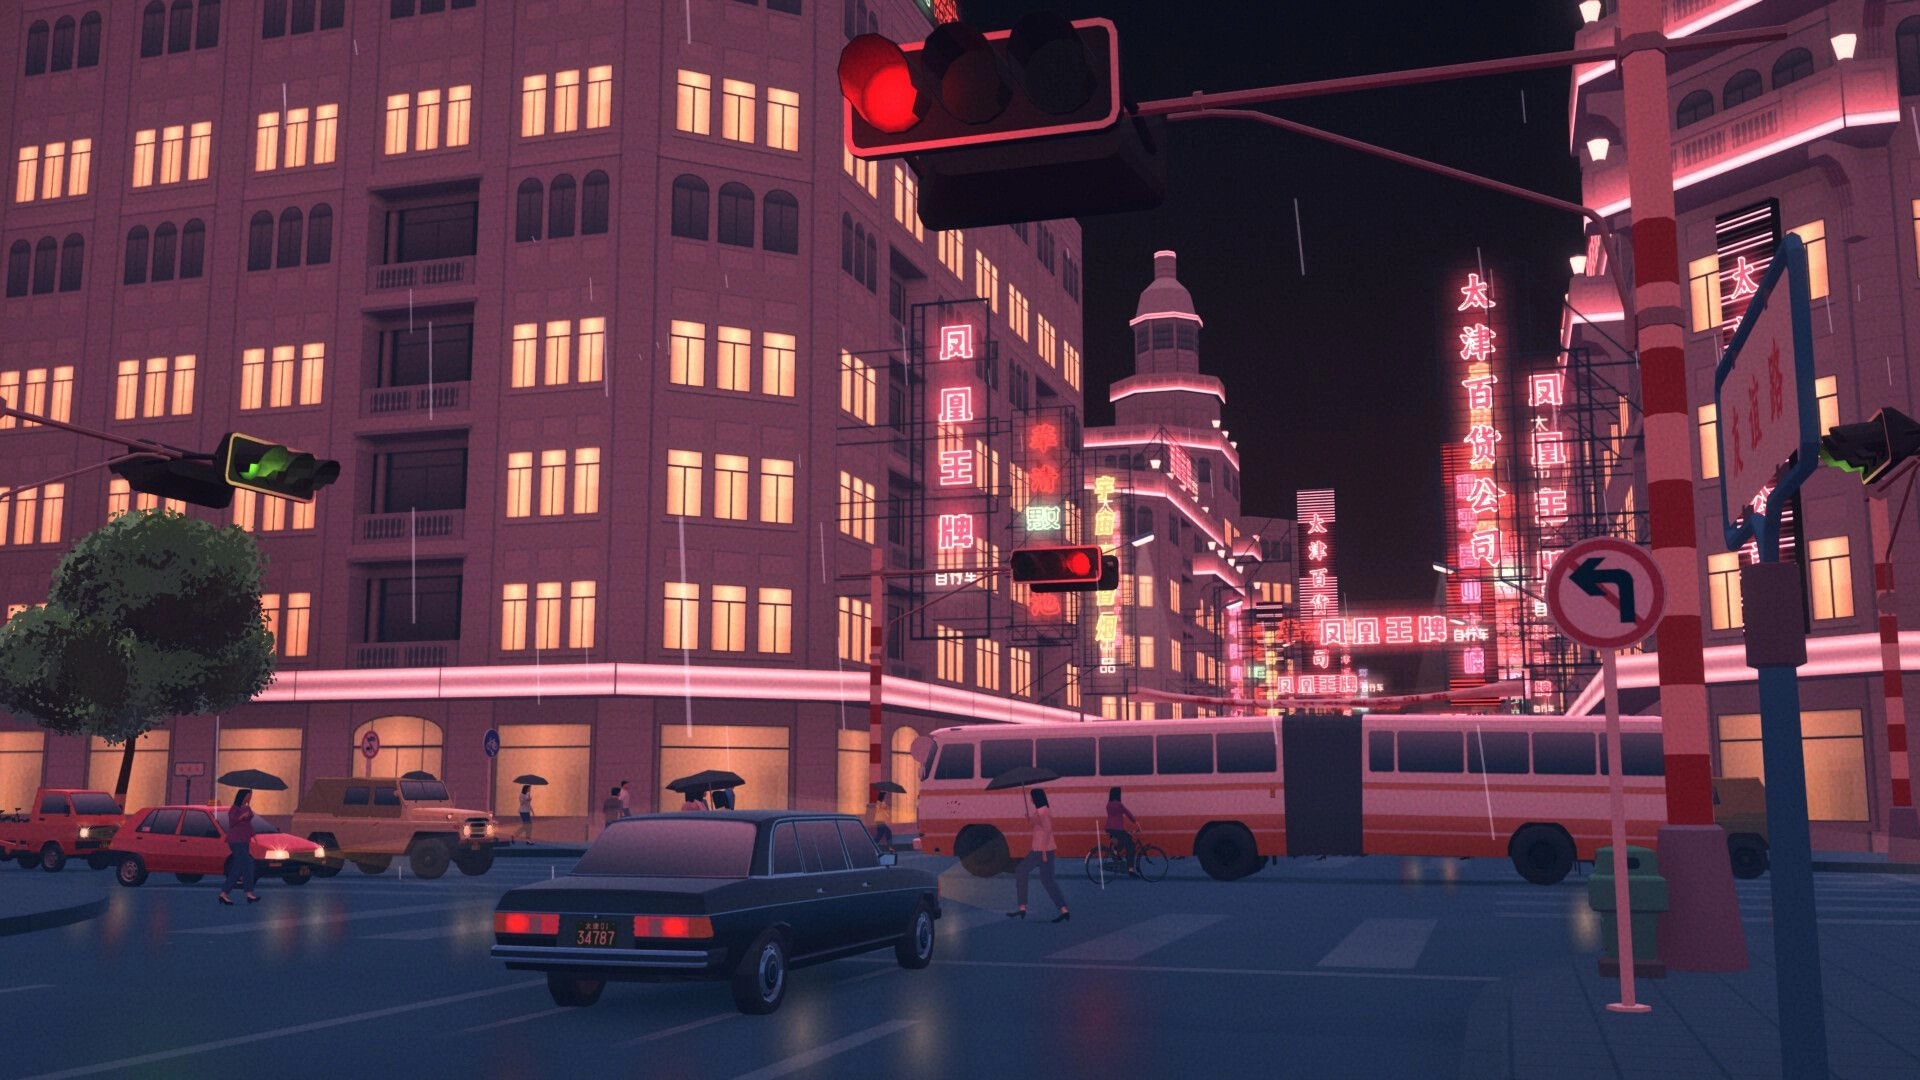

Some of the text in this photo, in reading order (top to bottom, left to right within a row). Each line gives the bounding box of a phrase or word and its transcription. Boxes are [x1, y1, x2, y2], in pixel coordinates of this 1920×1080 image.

[939, 324, 974, 549] 凤凰王牌
[1320, 615, 1447, 645] 凤凰王牌
[1453, 628, 1489, 642] 自行车
[1277, 674, 1357, 693] 凤凰王牌
[577, 930, 615, 945] 34787
